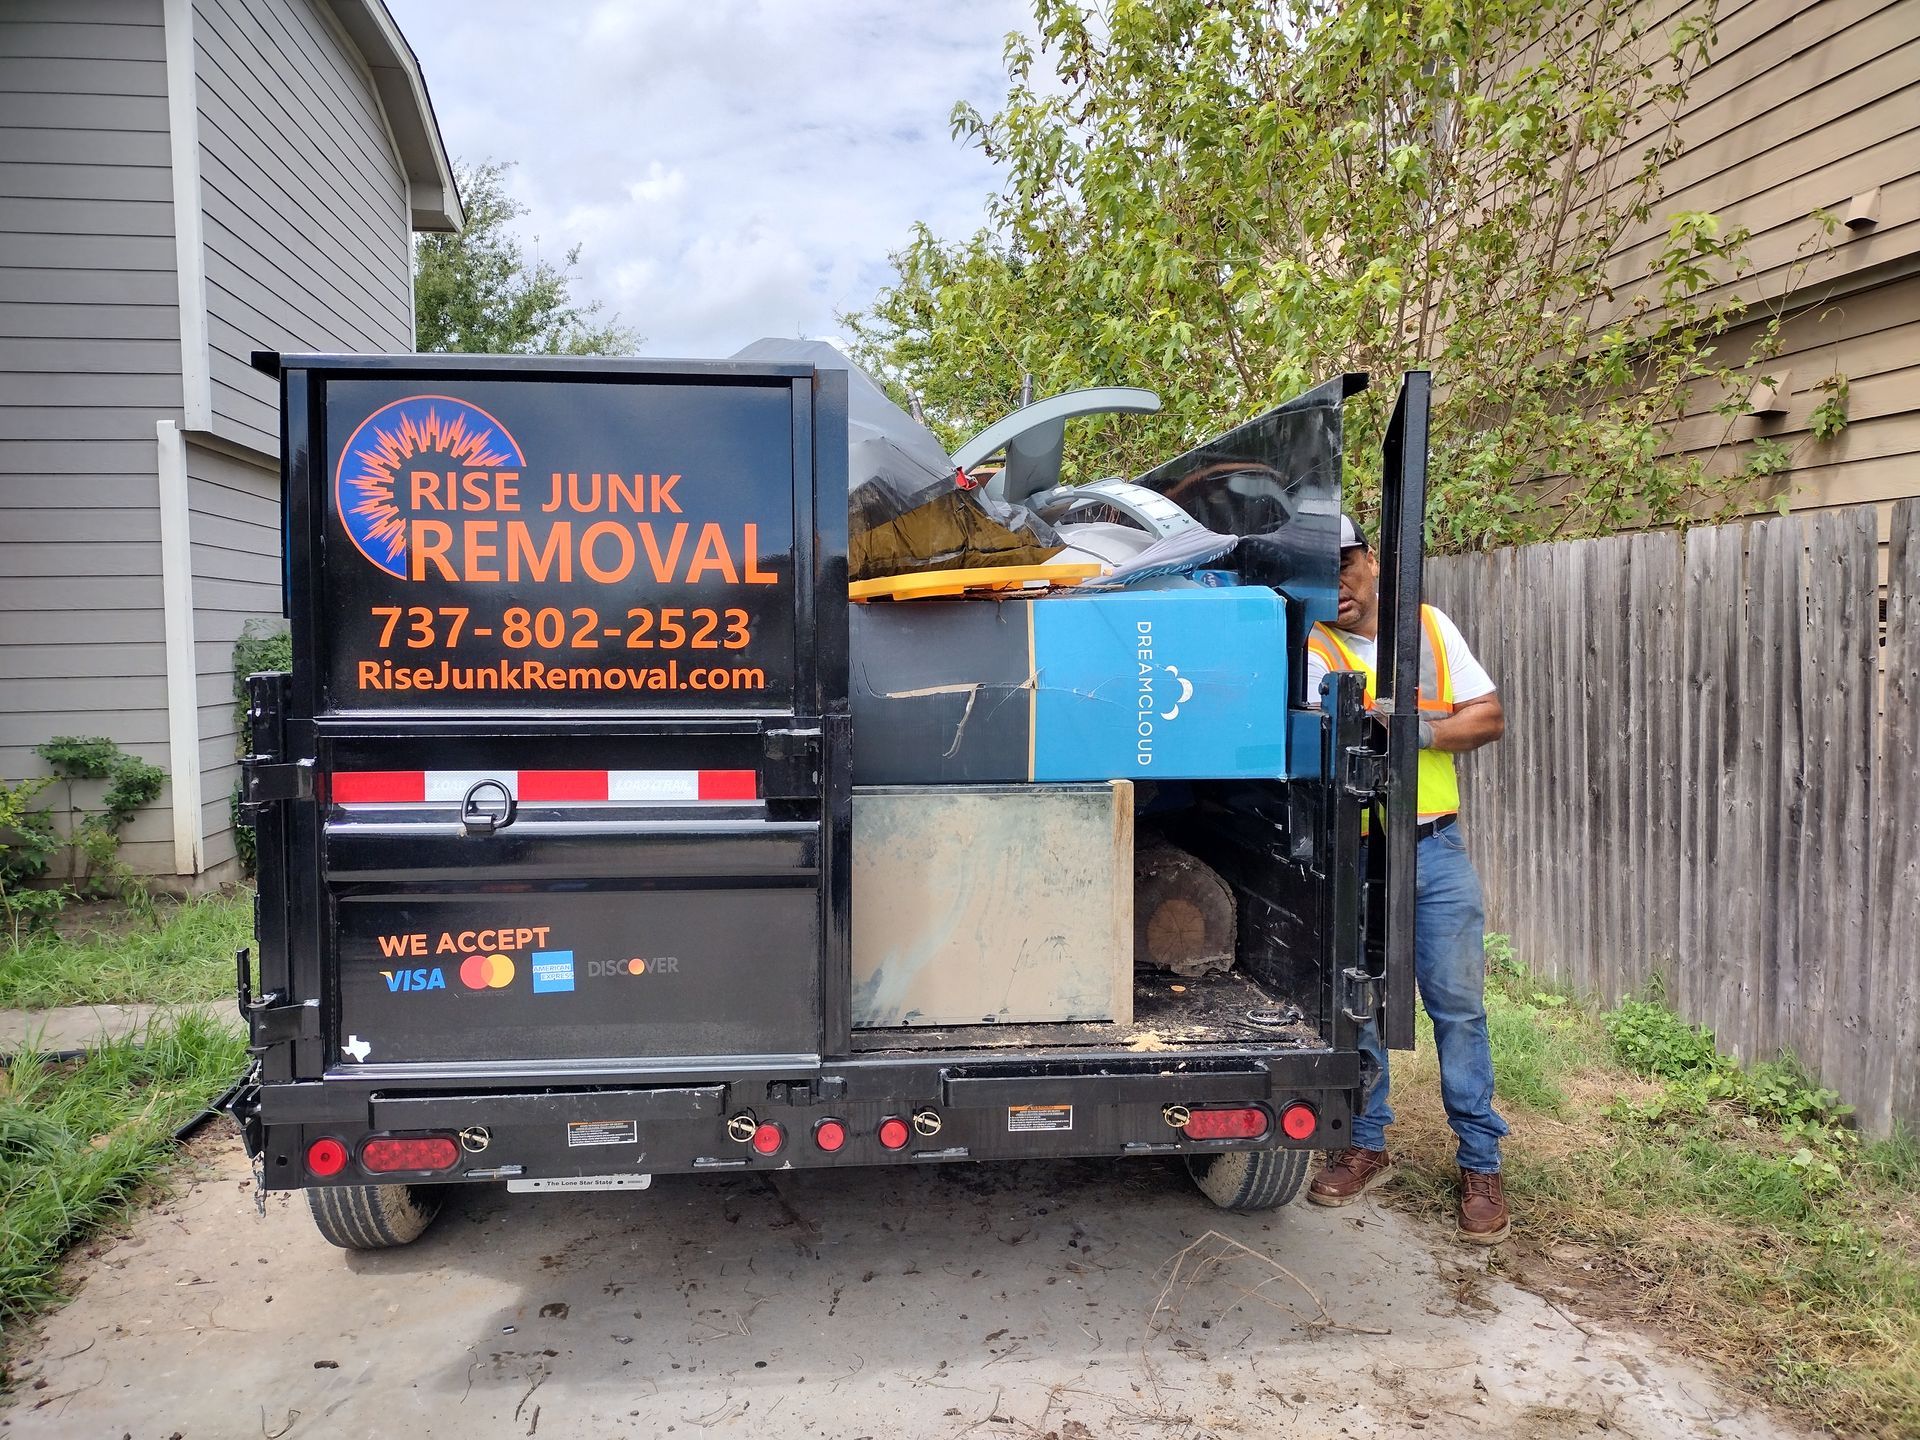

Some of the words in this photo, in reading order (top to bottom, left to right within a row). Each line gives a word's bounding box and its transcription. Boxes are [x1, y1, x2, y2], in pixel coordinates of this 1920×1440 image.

[411, 472, 520, 511] RISE
[543, 474, 682, 513] JUNK
[411, 520, 778, 584] REMOVAL
[371, 606, 750, 649] 737-802-2523
[358, 659, 765, 690] RiseJunkRemoval.com
[1136, 621, 1153, 766] DREAMCLOUD
[378, 934, 428, 957] WE
[436, 926, 550, 954] ACCEPT
[379, 968, 446, 992] VISA
[533, 964, 570, 972] AMERICAN
[588, 957, 679, 977] DISCOVER
